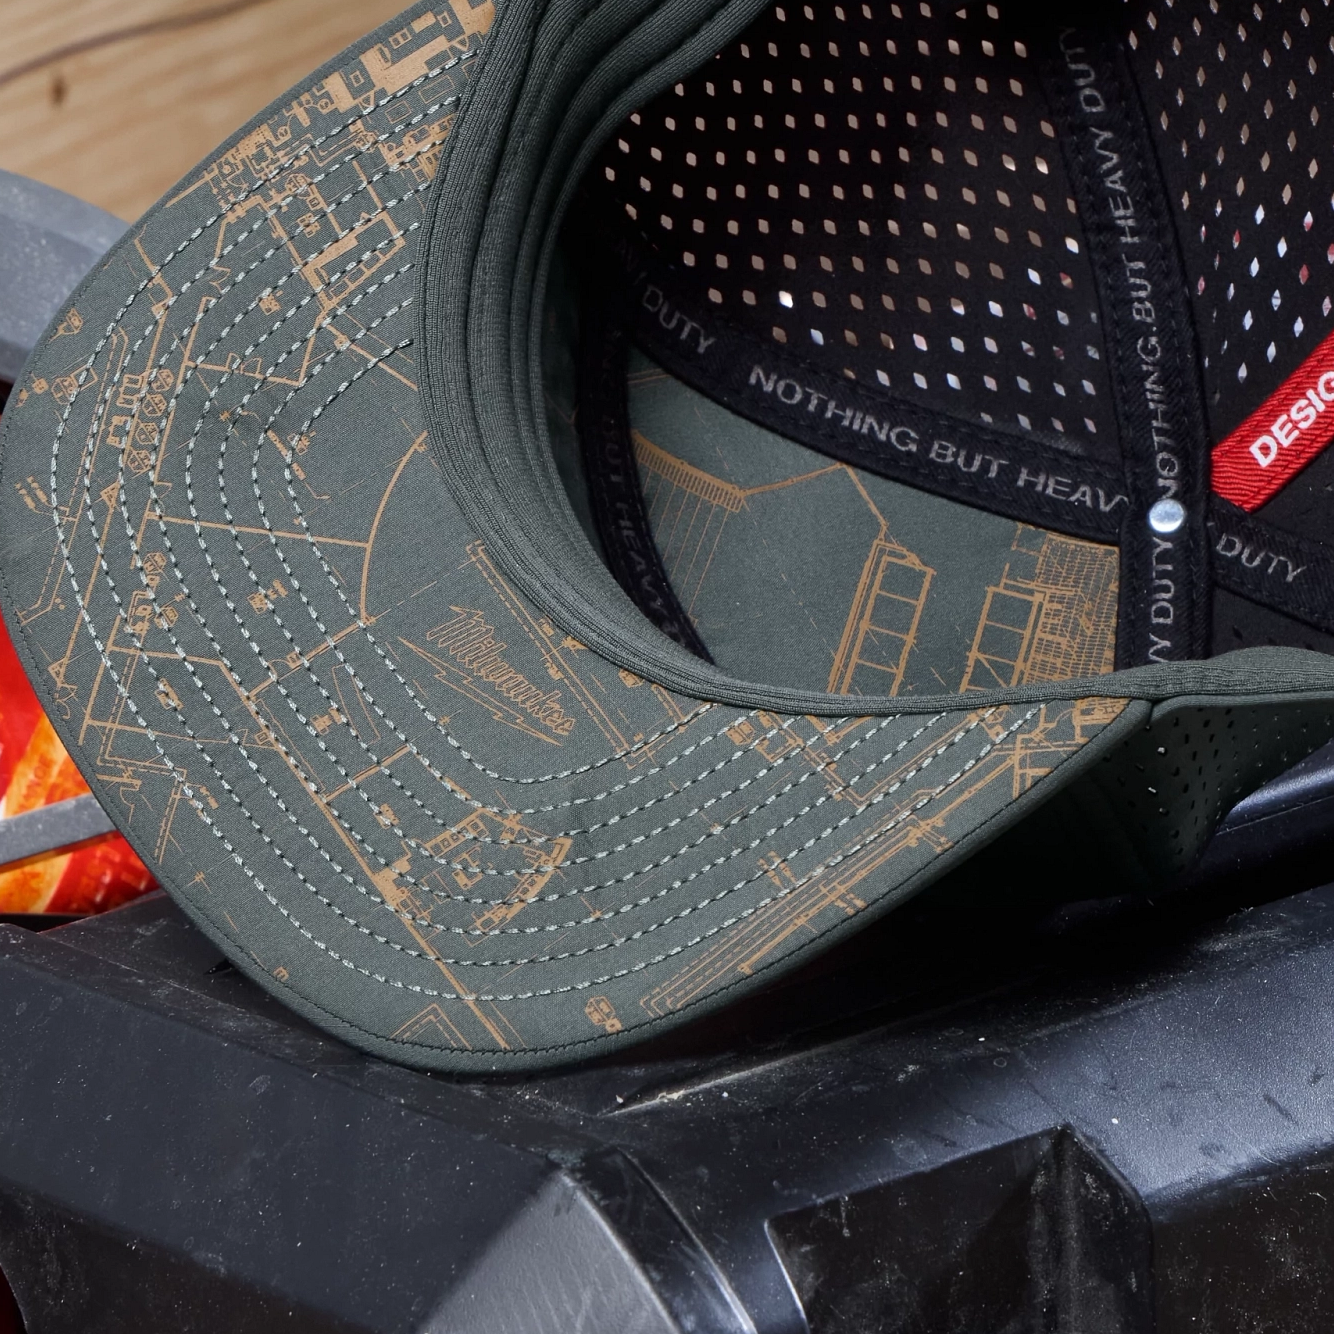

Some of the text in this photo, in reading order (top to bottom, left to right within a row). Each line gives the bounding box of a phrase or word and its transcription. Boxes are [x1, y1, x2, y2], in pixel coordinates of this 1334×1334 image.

[1091, 127, 1139, 246] HEAVY
[642, 283, 716, 355] DUTY
[1123, 255, 1153, 322] BUT
[747, 364, 1129, 515] NOTHING BUT HEAV
[1151, 538, 1175, 623] DUTY
[1216, 530, 1307, 583] DUTY
[426, 604, 575, 735] Milwaukee
